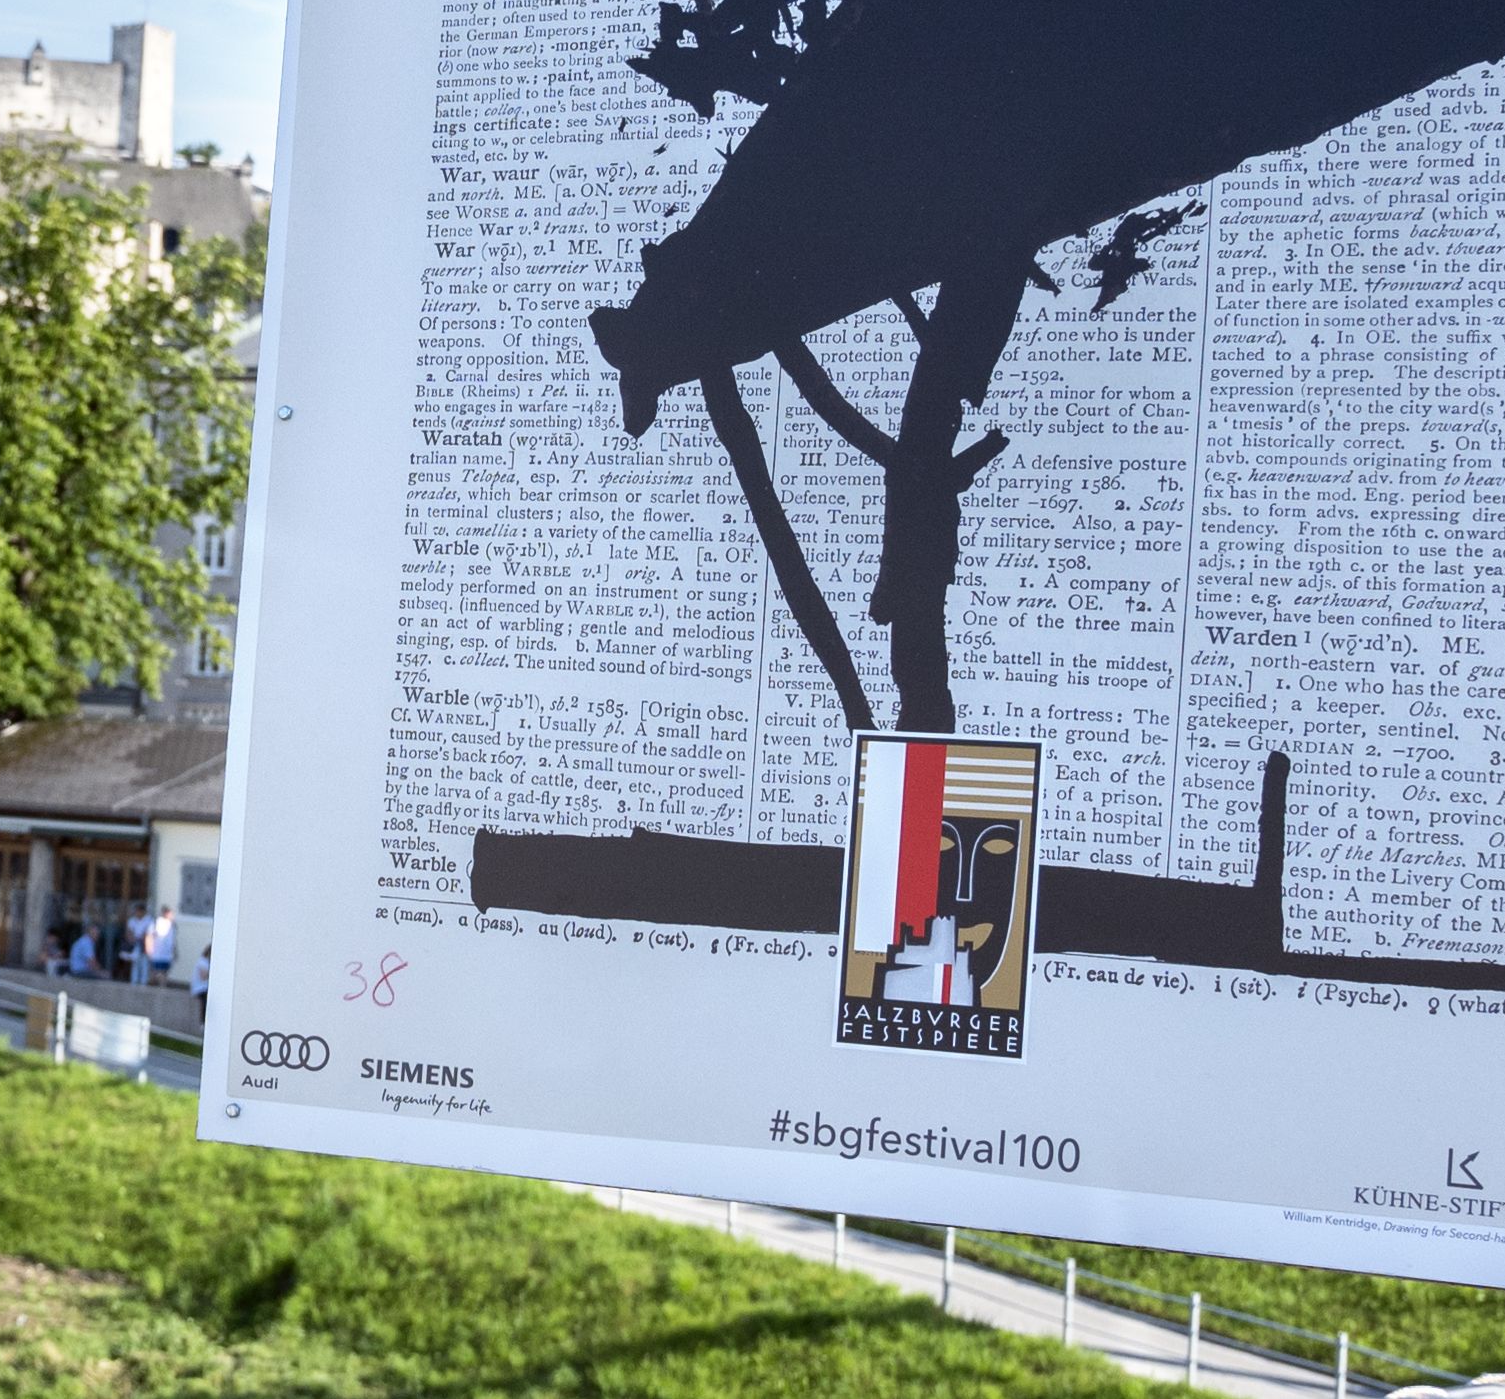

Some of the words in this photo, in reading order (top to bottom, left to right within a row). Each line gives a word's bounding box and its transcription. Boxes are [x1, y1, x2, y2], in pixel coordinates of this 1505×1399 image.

[1214, 294, 1261, 310] Later
[1264, 294, 1307, 310] there
[1311, 298, 1339, 310] are
[1343, 293, 1409, 310] isolated
[1414, 293, 1494, 313] examples
[415, 352, 463, 370] strong
[465, 349, 549, 371] opposition.
[554, 348, 589, 365] ME.
[420, 428, 503, 447] Waratah
[961, 608, 998, 627] One
[1007, 611, 1029, 628] of
[1035, 612, 1065, 630] the
[1074, 613, 1121, 632] three
[1129, 616, 1175, 634] main
[1193, 603, 1267, 626] however,
[1271, 606, 1312, 624] have
[1316, 607, 1355, 626] been
[1360, 610, 1433, 628] confined
[1438, 615, 1456, 629] to
[1185, 711, 1294, 735] gatekeeper,
[1301, 719, 1367, 739] porter,
[1376, 720, 1459, 741] sentinel.
[388, 726, 447, 745] tumour,
[450, 730, 501, 746] caused
[505, 730, 525, 751] by
[527, 732, 552, 749] the
[553, 738, 619, 754] pressure
[620, 738, 639, 755] of
[641, 739, 667, 757] the
[669, 742, 723, 760] saddle
[725, 749, 746, 761] on
[385, 760, 410, 781] ing
[413, 766, 433, 778] on
[439, 764, 464, 780] the
[468, 765, 503, 784] back
[509, 768, 527, 785] of
[529, 771, 578, 791] cattle,
[582, 773, 622, 795] deer,
[627, 779, 662, 797] etc.,
[667, 781, 744, 800] produced
[1287, 902, 1318, 921] the
[1323, 906, 1414, 931] authority
[1419, 912, 1442, 930] of
[1450, 914, 1482, 932] the
[343, 952, 408, 1007] 38
[842, 1022, 1018, 1053] FESTSPIELE
[242, 1074, 279, 1090] Audi
[360, 1058, 475, 1089] SIEMENS
[381, 1089, 444, 1115] Ingenuity
[445, 1096, 468, 1114] for
[469, 1098, 493, 1116] life
[769, 1110, 1081, 1174] #sbgfestival100
[1283, 1210, 1322, 1224] William
[1325, 1215, 1380, 1232] Kentridge,
[1383, 1222, 1429, 1238] Drawing
[1431, 1225, 1447, 1238] for
